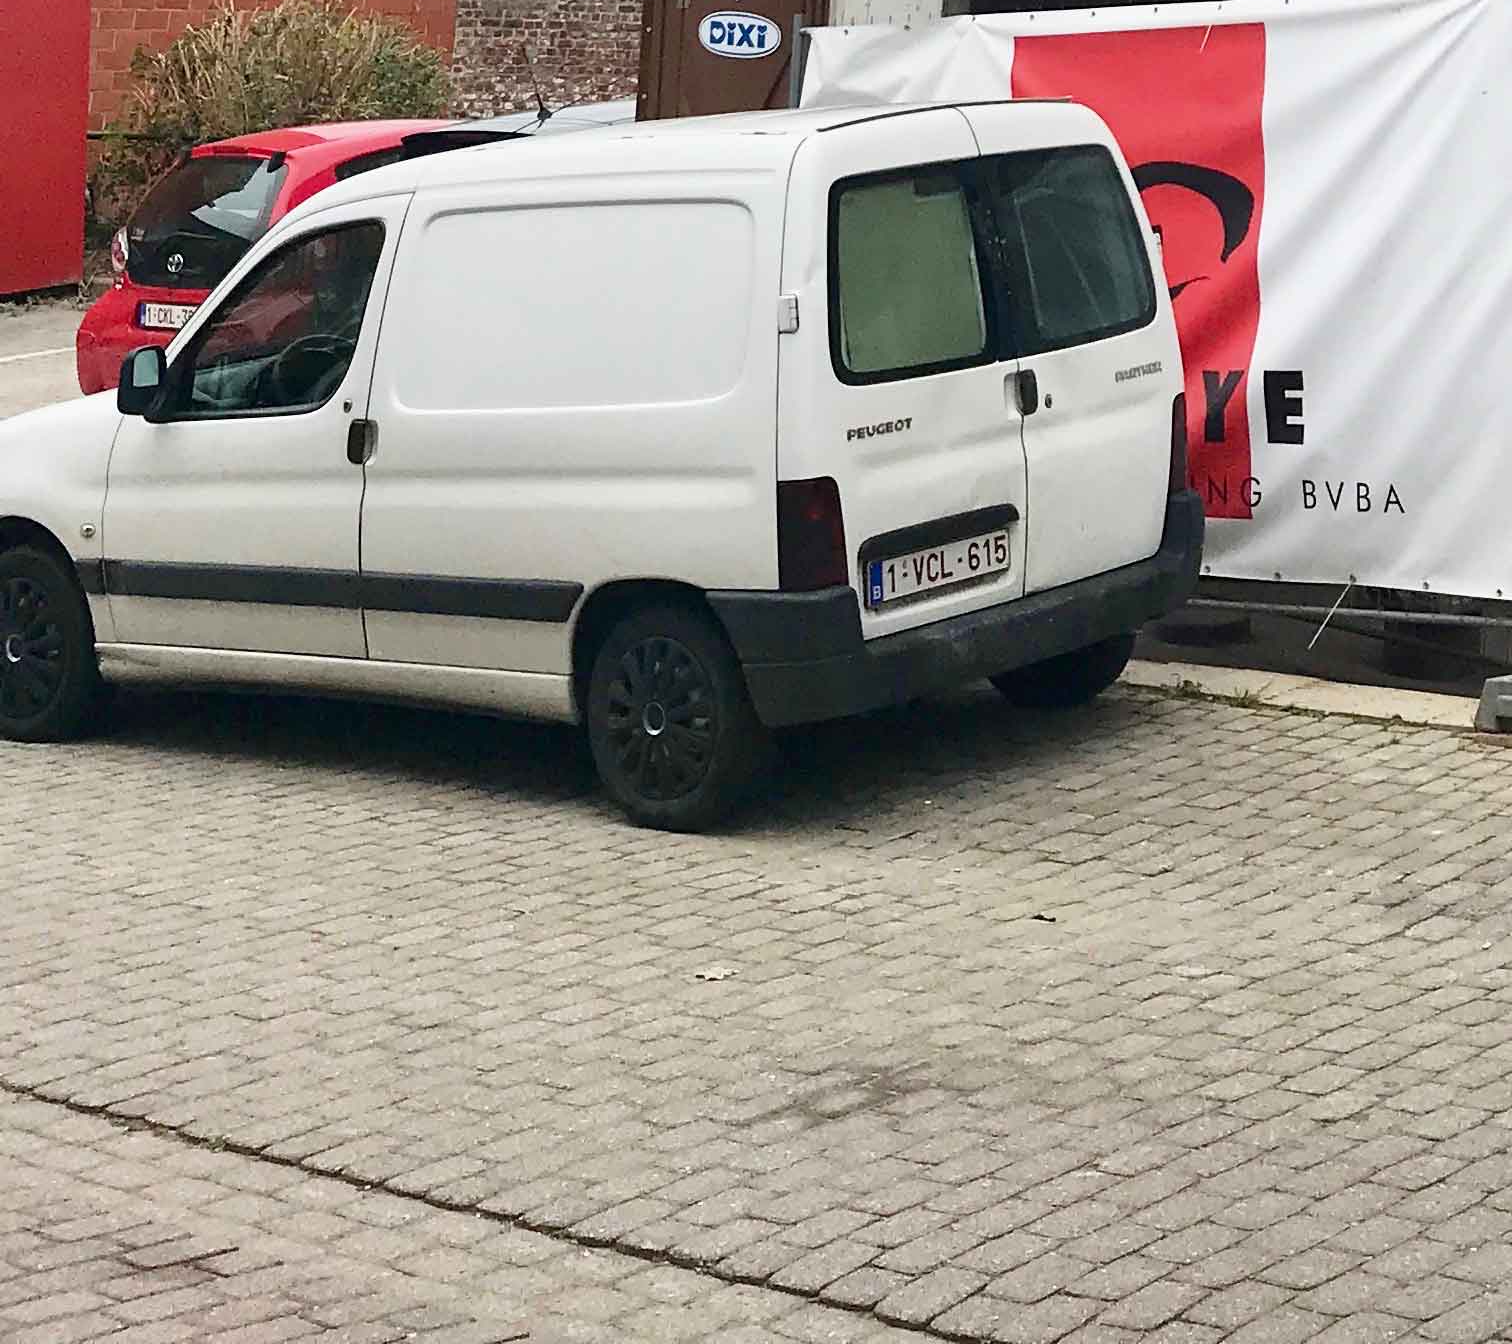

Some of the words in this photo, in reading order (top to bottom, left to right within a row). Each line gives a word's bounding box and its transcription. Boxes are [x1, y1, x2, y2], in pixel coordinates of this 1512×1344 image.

[847, 417, 913, 442] PEUGEOT
[1302, 479, 1405, 514] BVBA
[872, 585, 881, 600] B
